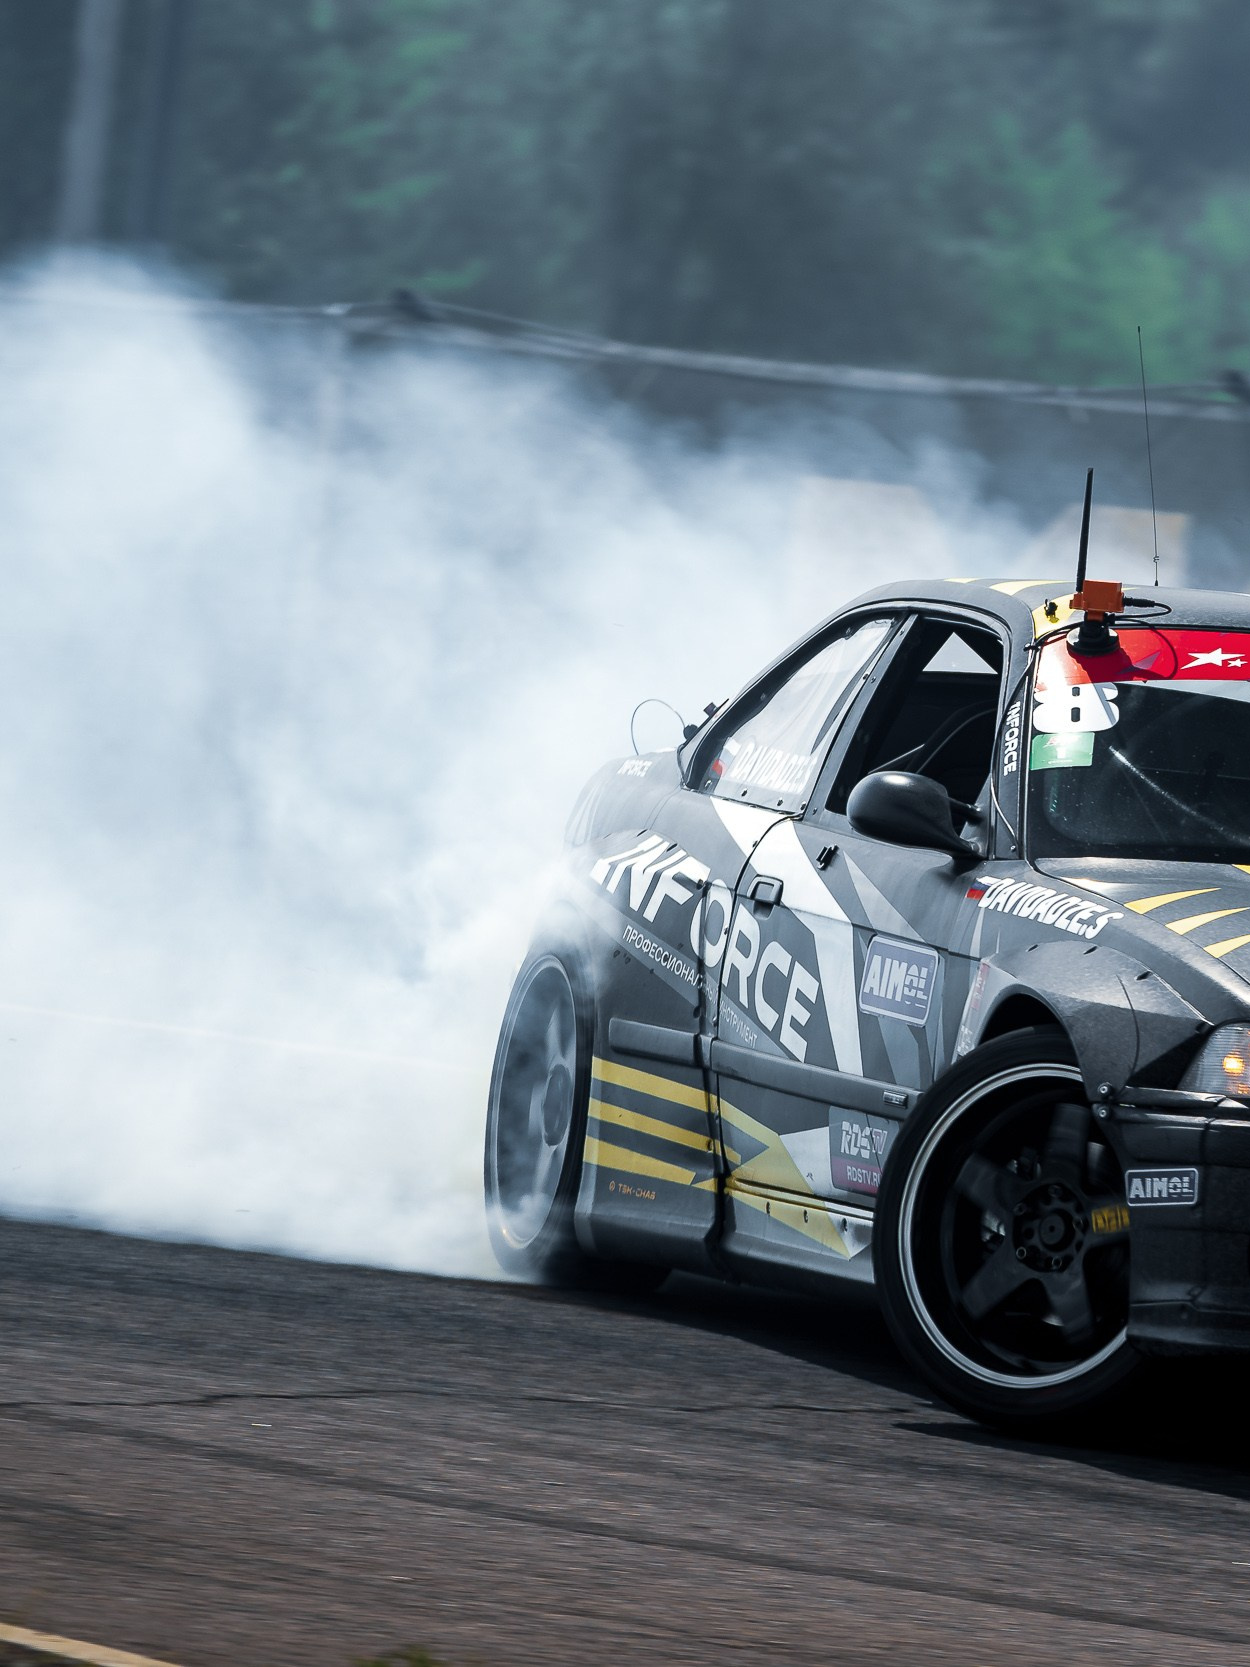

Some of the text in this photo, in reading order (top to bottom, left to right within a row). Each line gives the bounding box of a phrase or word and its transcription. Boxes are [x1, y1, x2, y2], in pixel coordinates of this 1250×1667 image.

[1003, 701, 1021, 776] INFORCE
[589, 834, 820, 1063] INFORCE
[863, 954, 929, 1009] AIMOL
[1129, 1176, 1194, 1198] AIMOL
